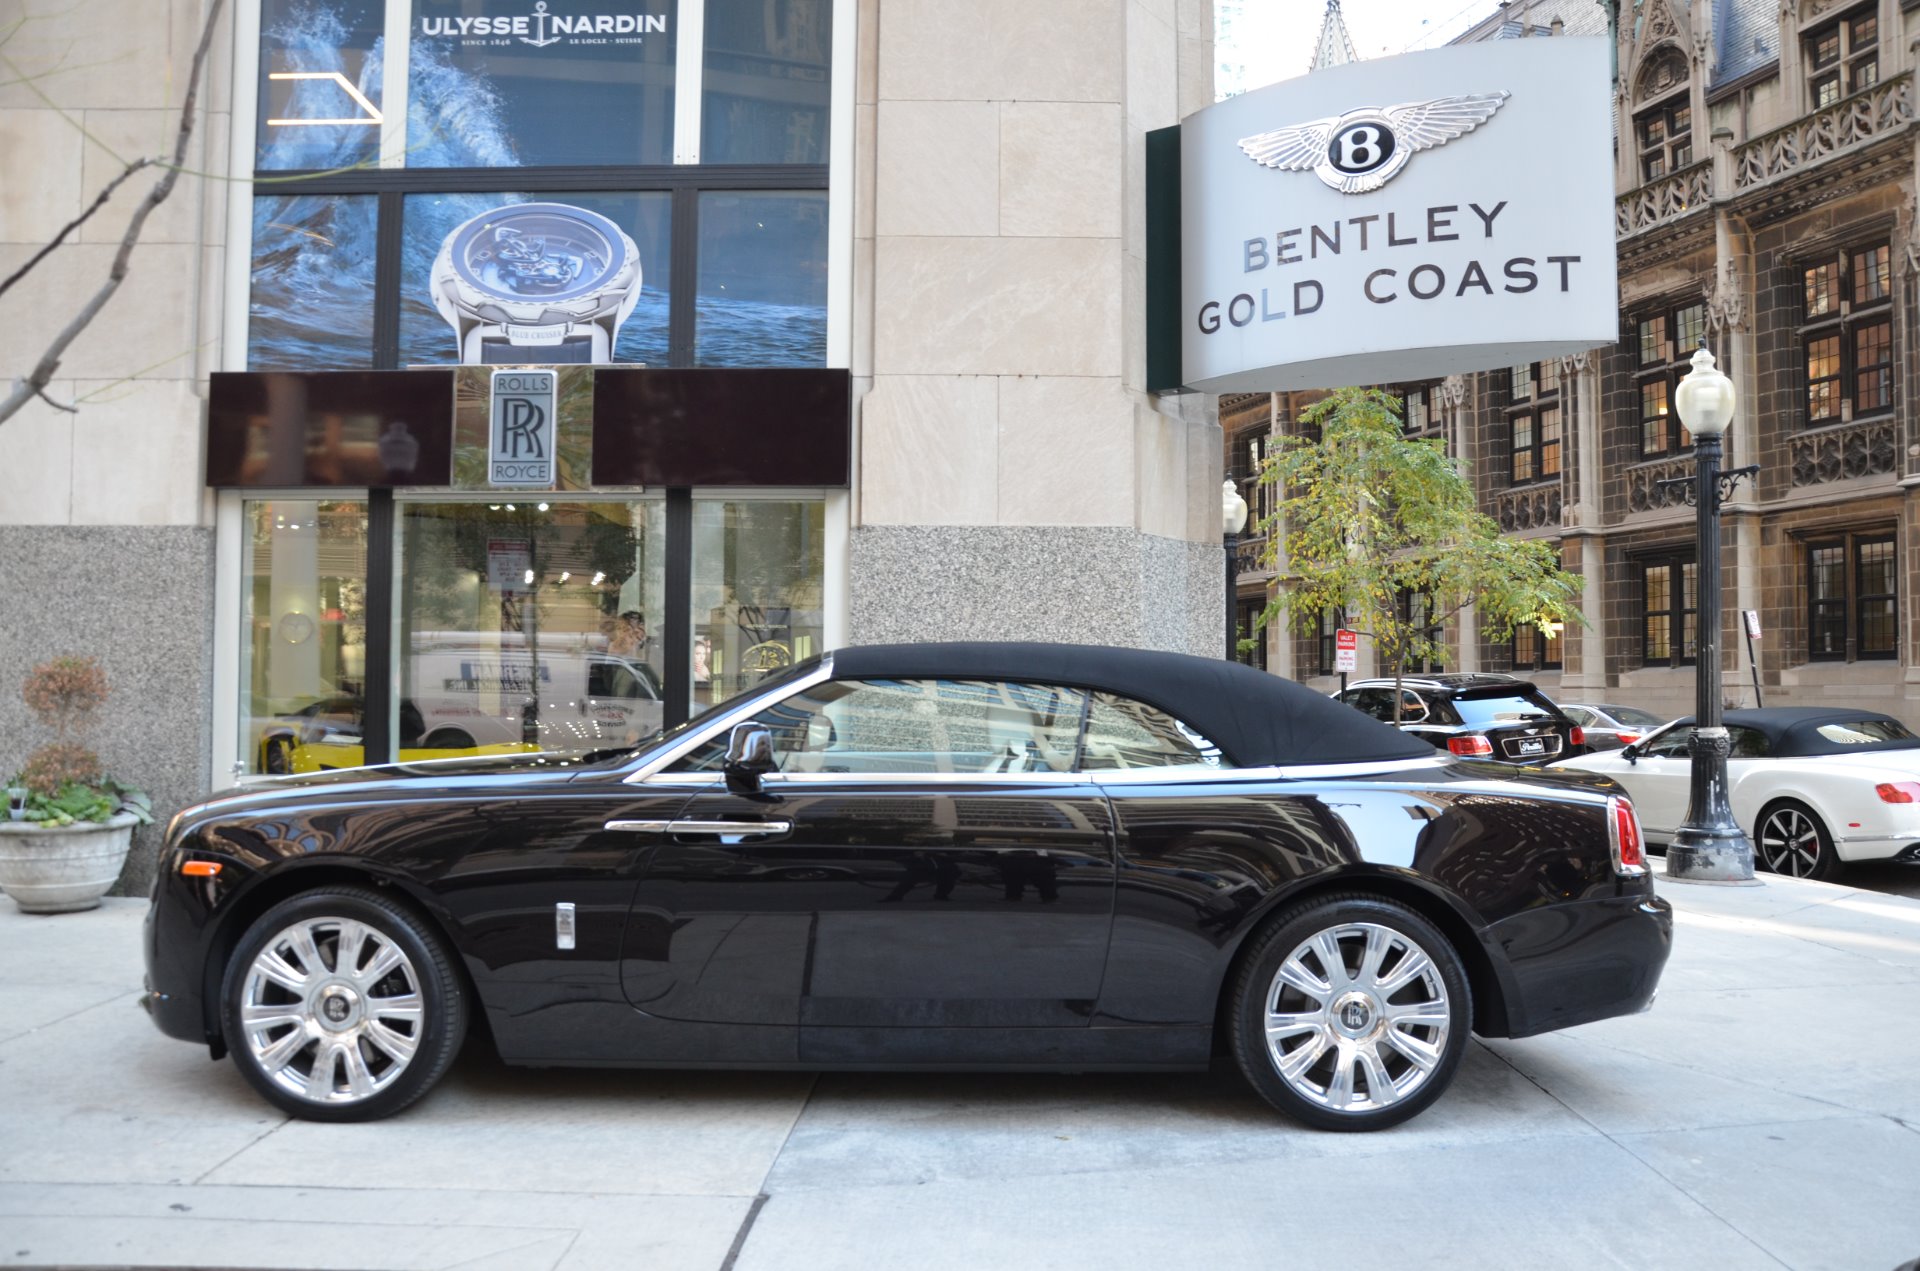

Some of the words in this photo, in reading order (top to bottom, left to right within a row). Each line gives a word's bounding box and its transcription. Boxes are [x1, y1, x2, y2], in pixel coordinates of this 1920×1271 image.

[422, 16, 529, 35] ULYSSE
[552, 15, 666, 33] NARDIN
[1340, 125, 1381, 169] B
[1243, 201, 1508, 273] BENTLEY
[1198, 279, 1324, 335] GOLD
[1364, 256, 1581, 304] COAST
[498, 378, 548, 391] ROLLS
[495, 465, 546, 478] ROYCE
